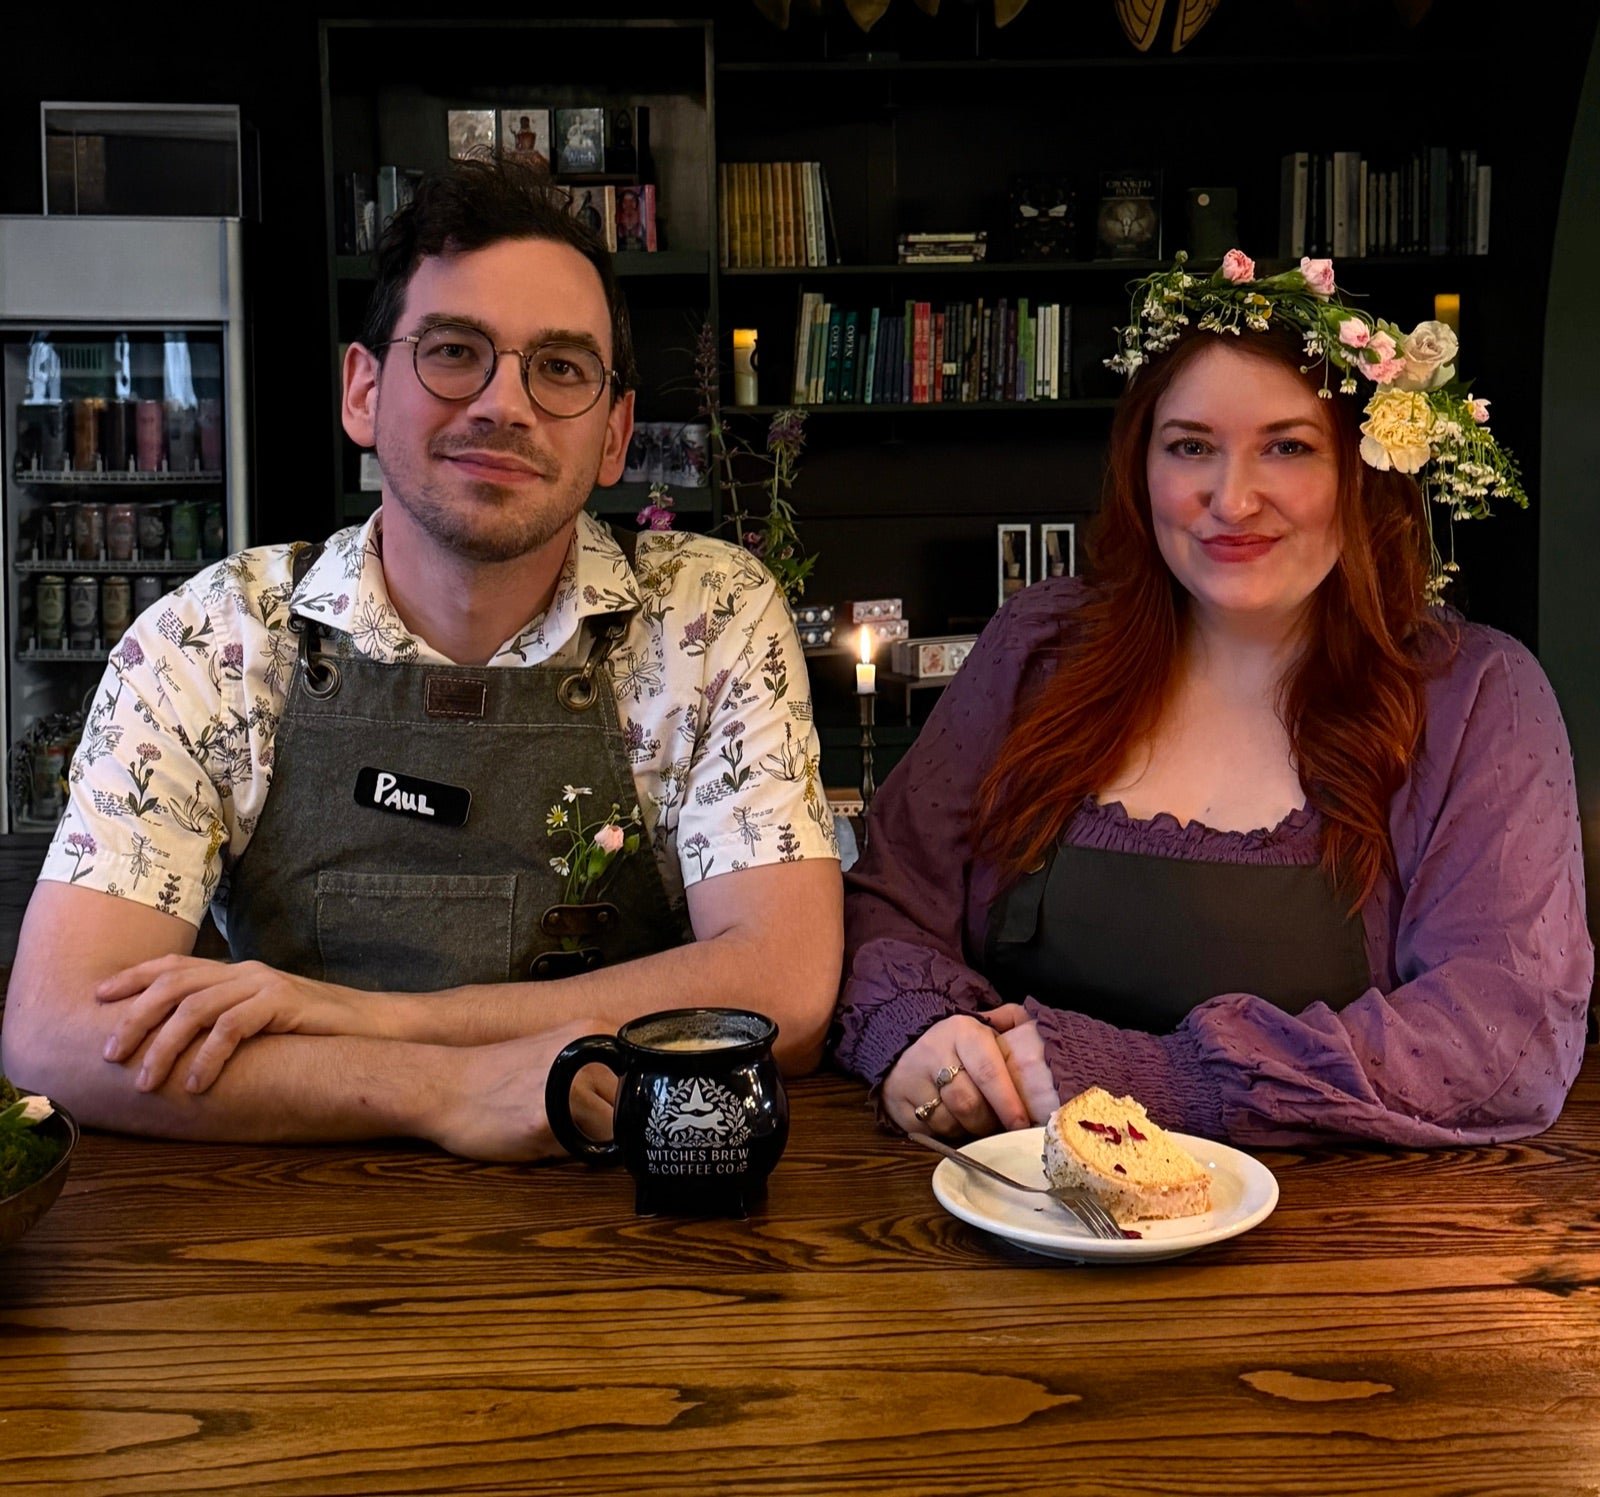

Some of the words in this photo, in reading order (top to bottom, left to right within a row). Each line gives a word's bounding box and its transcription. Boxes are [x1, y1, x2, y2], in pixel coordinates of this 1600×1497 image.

[374, 773, 435, 816] PAUL
[647, 1149, 706, 1161] WITCHES
[711, 1148, 749, 1161] BREW
[661, 1163, 711, 1175] COFFEE
[716, 1163, 735, 1175] CO
